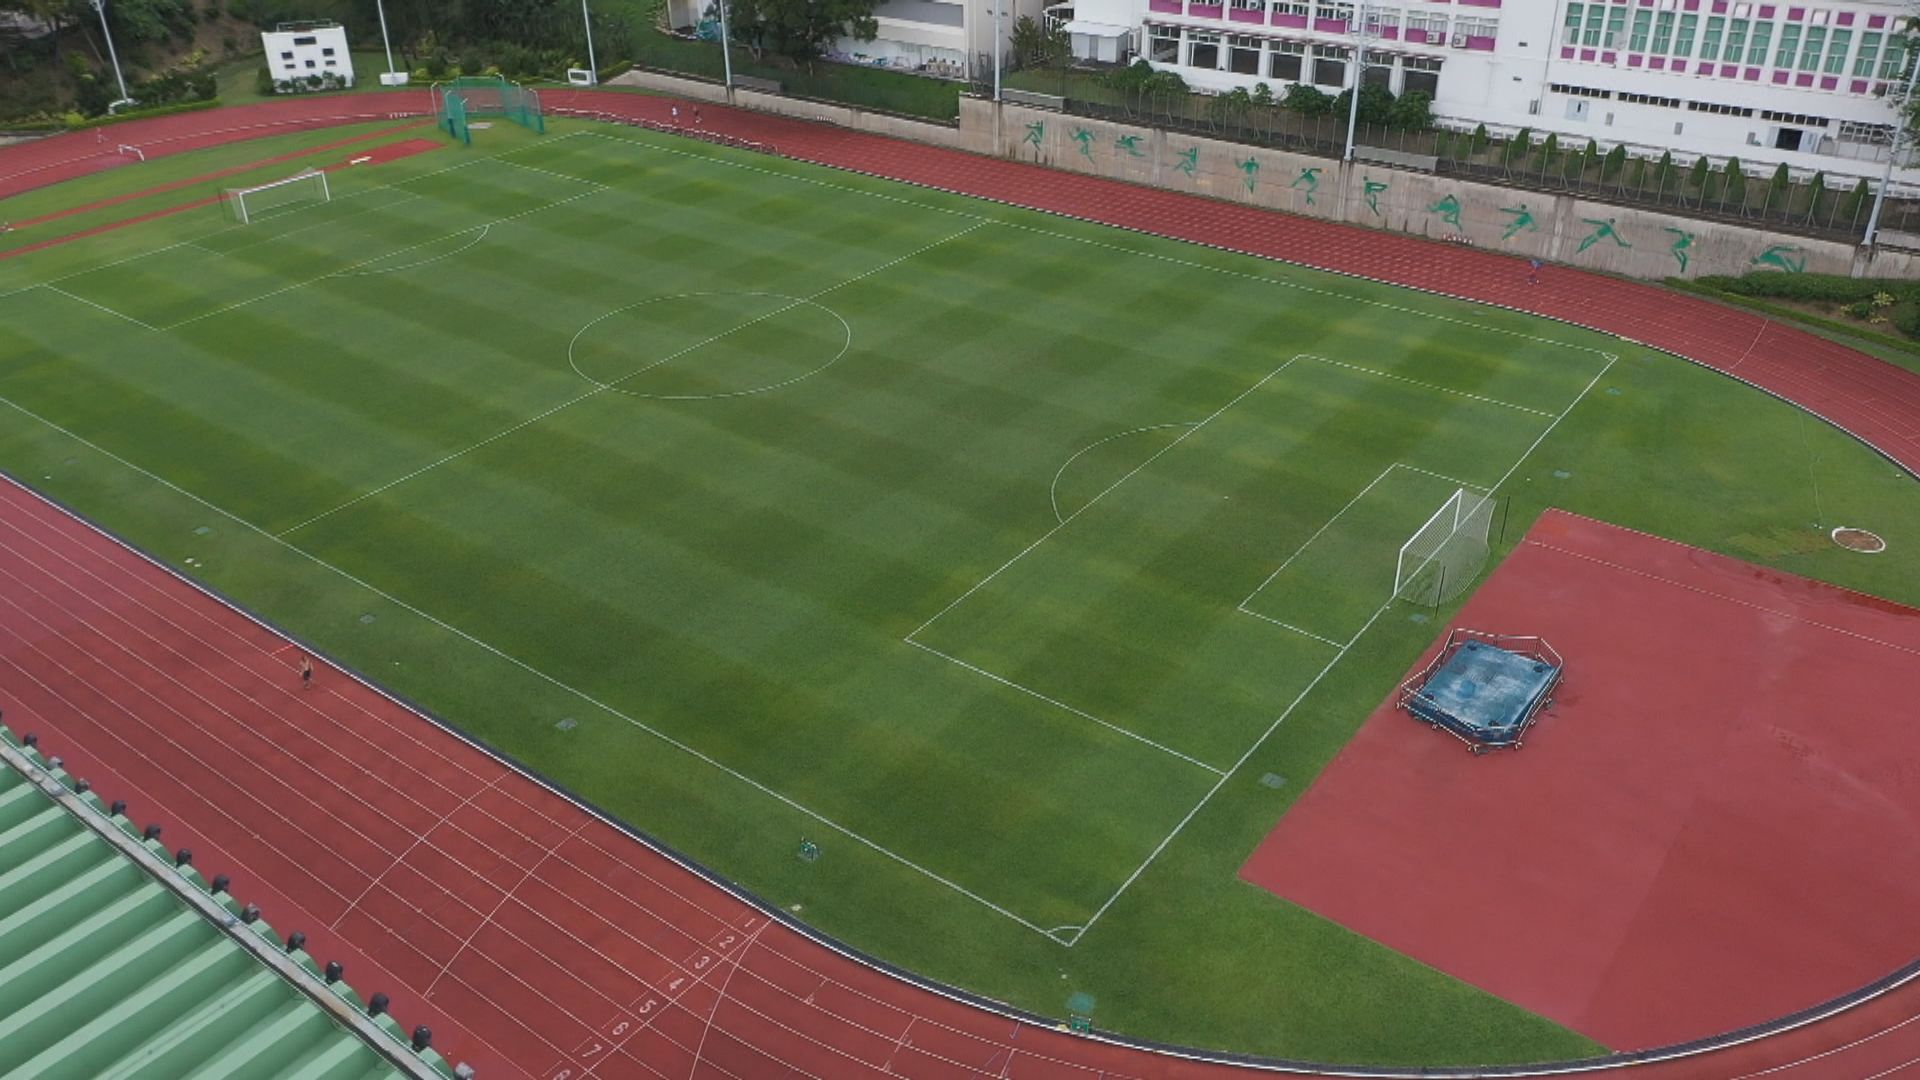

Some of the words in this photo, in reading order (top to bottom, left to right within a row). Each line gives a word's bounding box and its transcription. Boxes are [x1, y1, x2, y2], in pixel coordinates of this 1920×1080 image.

[743, 918, 756, 928] 1
[719, 936, 734, 948] 2
[695, 956, 710, 969] 3
[668, 978, 684, 991] 4
[639, 1000, 657, 1013] 5
[612, 1022, 629, 1035] 6
[582, 1044, 602, 1057] 7
[553, 1069, 571, 1080] 8
